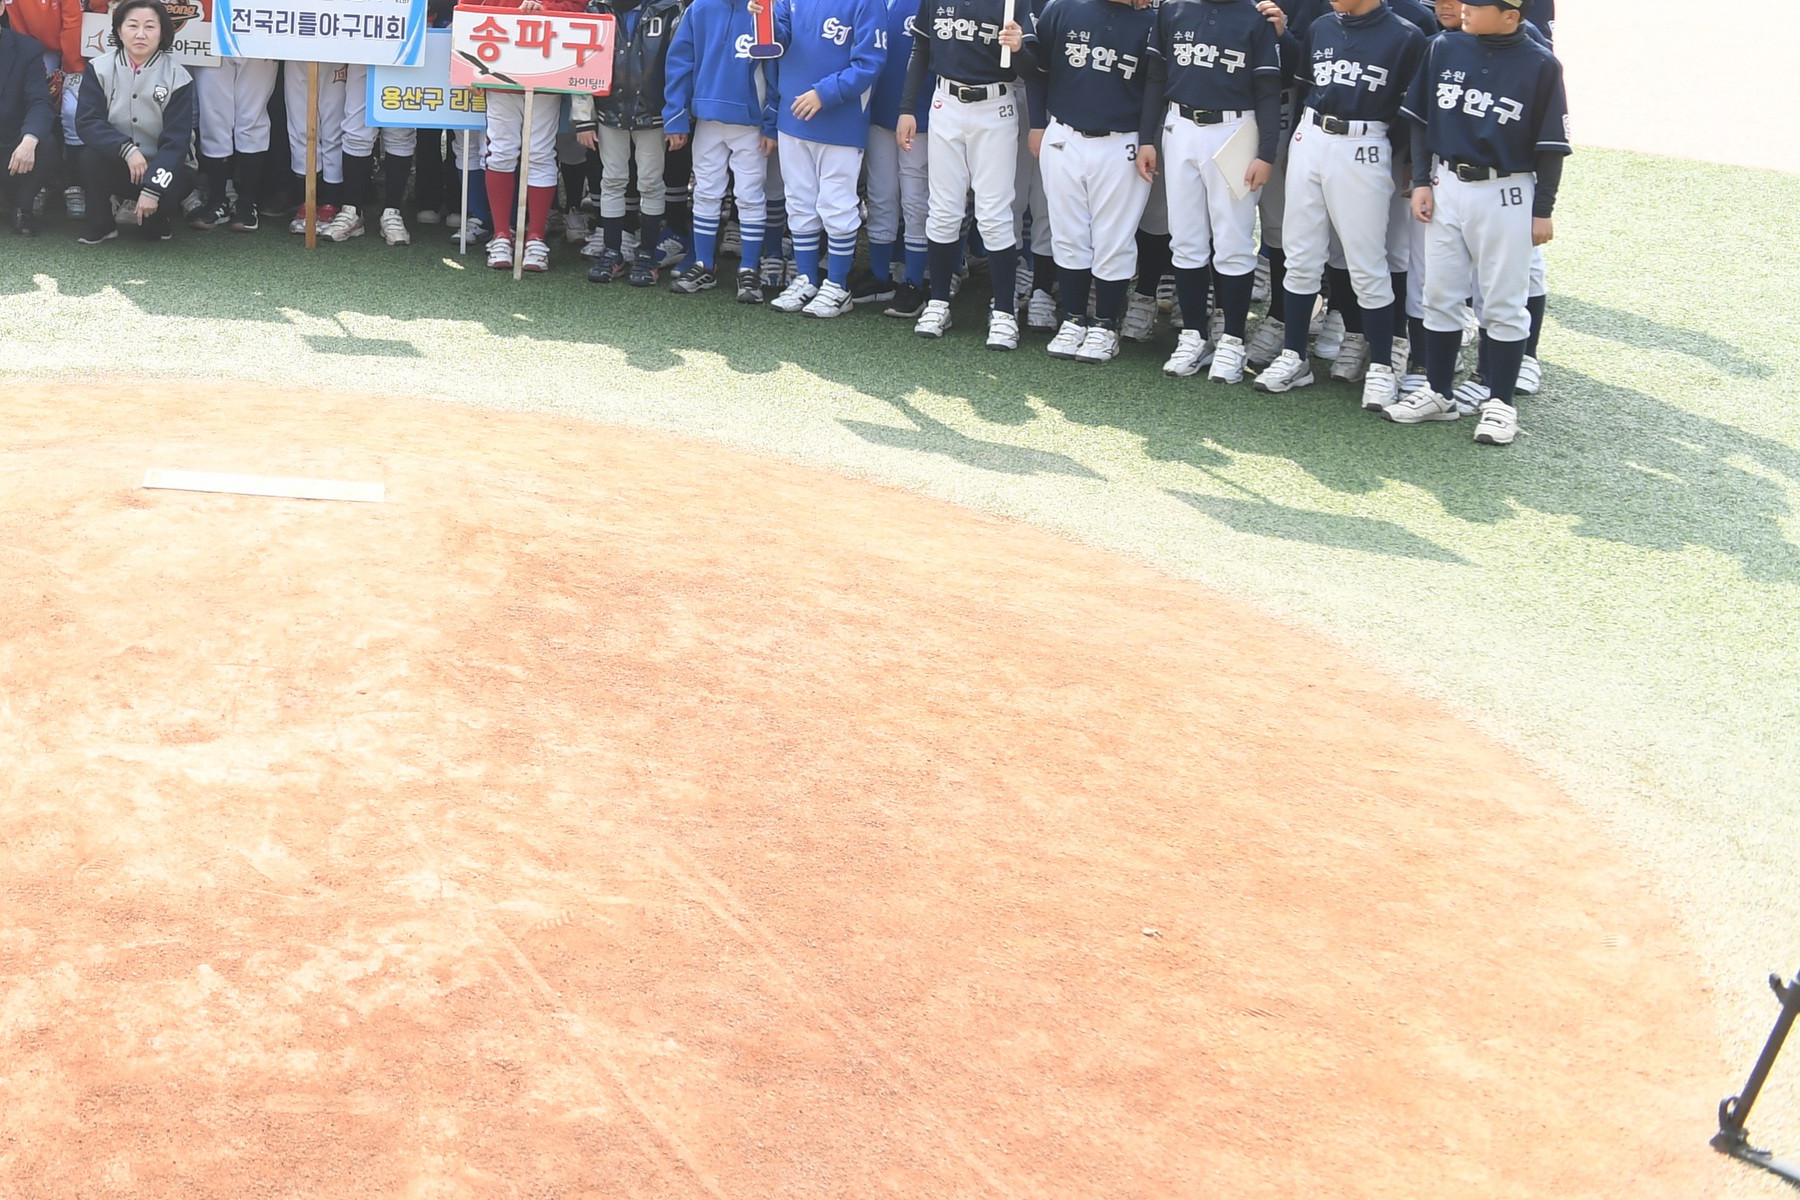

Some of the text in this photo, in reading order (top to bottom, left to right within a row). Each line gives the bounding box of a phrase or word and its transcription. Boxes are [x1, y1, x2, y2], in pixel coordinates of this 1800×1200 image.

[936, 7, 955, 17] 수원
[231, 8, 406, 40] 전국리틀야구대회
[647, 16, 662, 37] D
[933, 18, 1000, 45] 장안구
[469, 16, 604, 67] 송파구
[1066, 29, 1091, 43] 수원
[1174, 31, 1194, 42] 수원
[1065, 41, 1139, 80] 장안구
[1173, 43, 1246, 73] 장안구
[1312, 48, 1334, 60] 수원
[1313, 60, 1389, 92] 장안구
[1440, 69, 1466, 82] 수원
[381, 86, 443, 112] 용산구
[1436, 83, 1524, 125] 장안구
[999, 104, 1014, 117] 23
[1354, 146, 1380, 164] 48
[1500, 187, 1523, 207] 18
